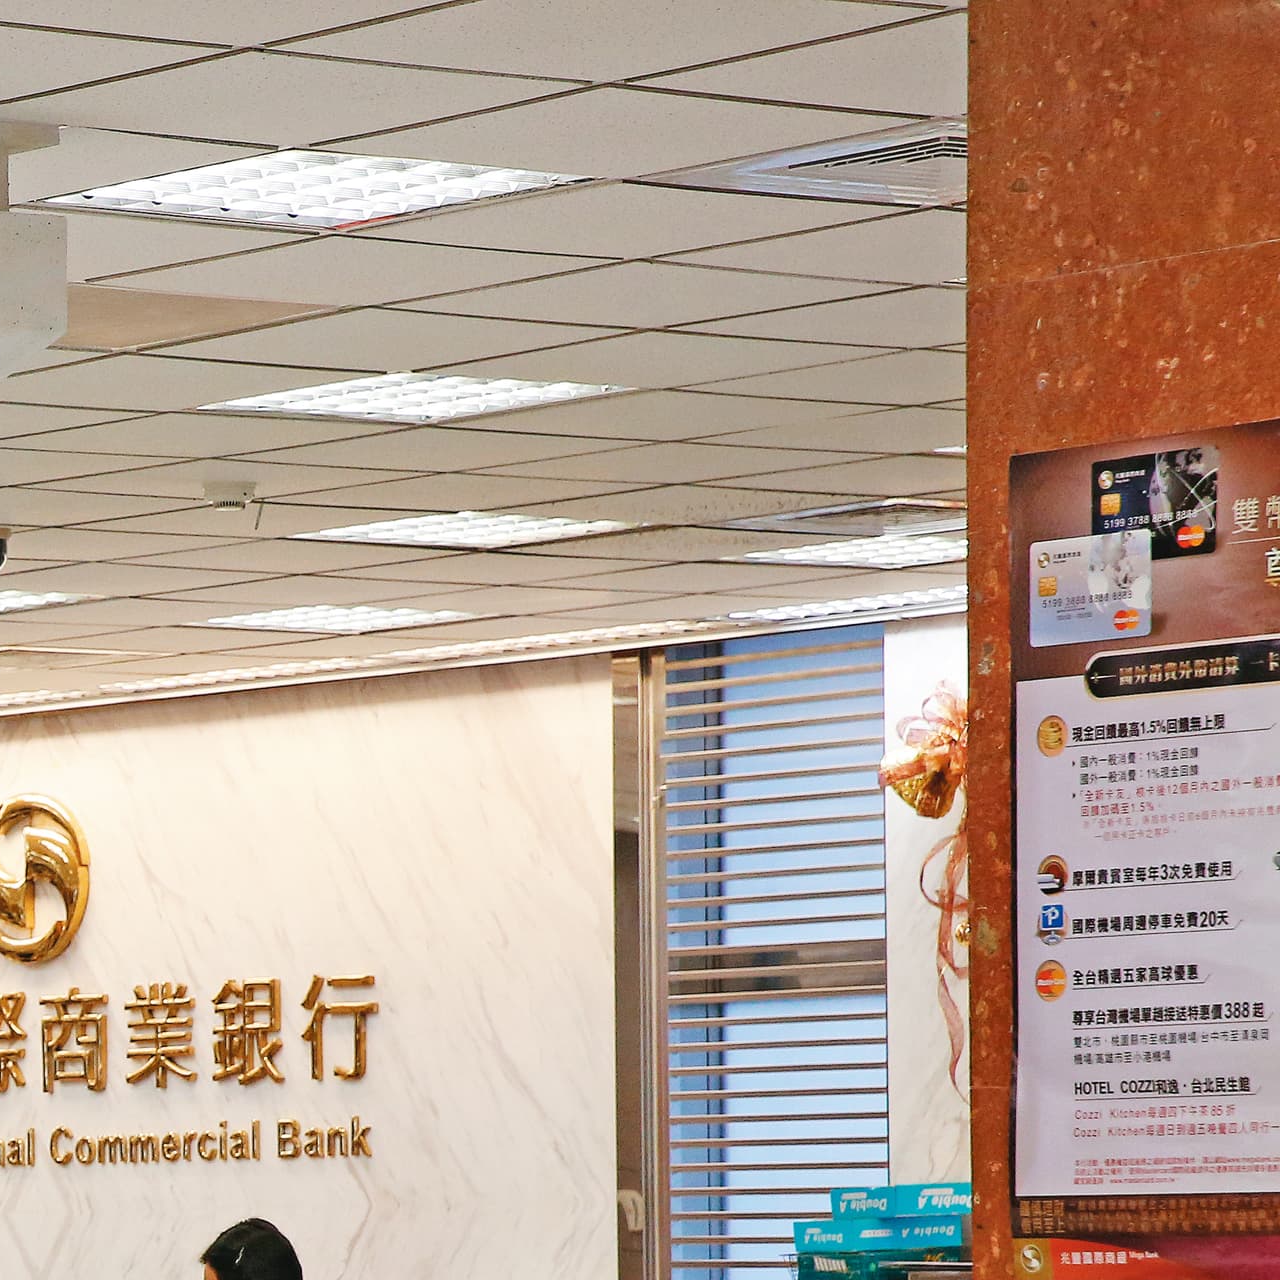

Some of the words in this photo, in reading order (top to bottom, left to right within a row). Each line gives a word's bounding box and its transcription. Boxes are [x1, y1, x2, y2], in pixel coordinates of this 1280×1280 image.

[1072, 860, 1233, 887] 摩爾貴賓室每年3次免費使用
[1072, 964, 1199, 987] 全台精選五家高球優惠
[1074, 1080, 1114, 1096] HOTEL
[49, 1120, 261, 1167] Commercial
[276, 1115, 373, 1160] Bank
[839, 1200, 847, 1213] A
[850, 1197, 888, 1212] Double
[917, 1196, 928, 1210] A
[901, 1227, 911, 1238] A
[913, 1225, 955, 1237] Double
